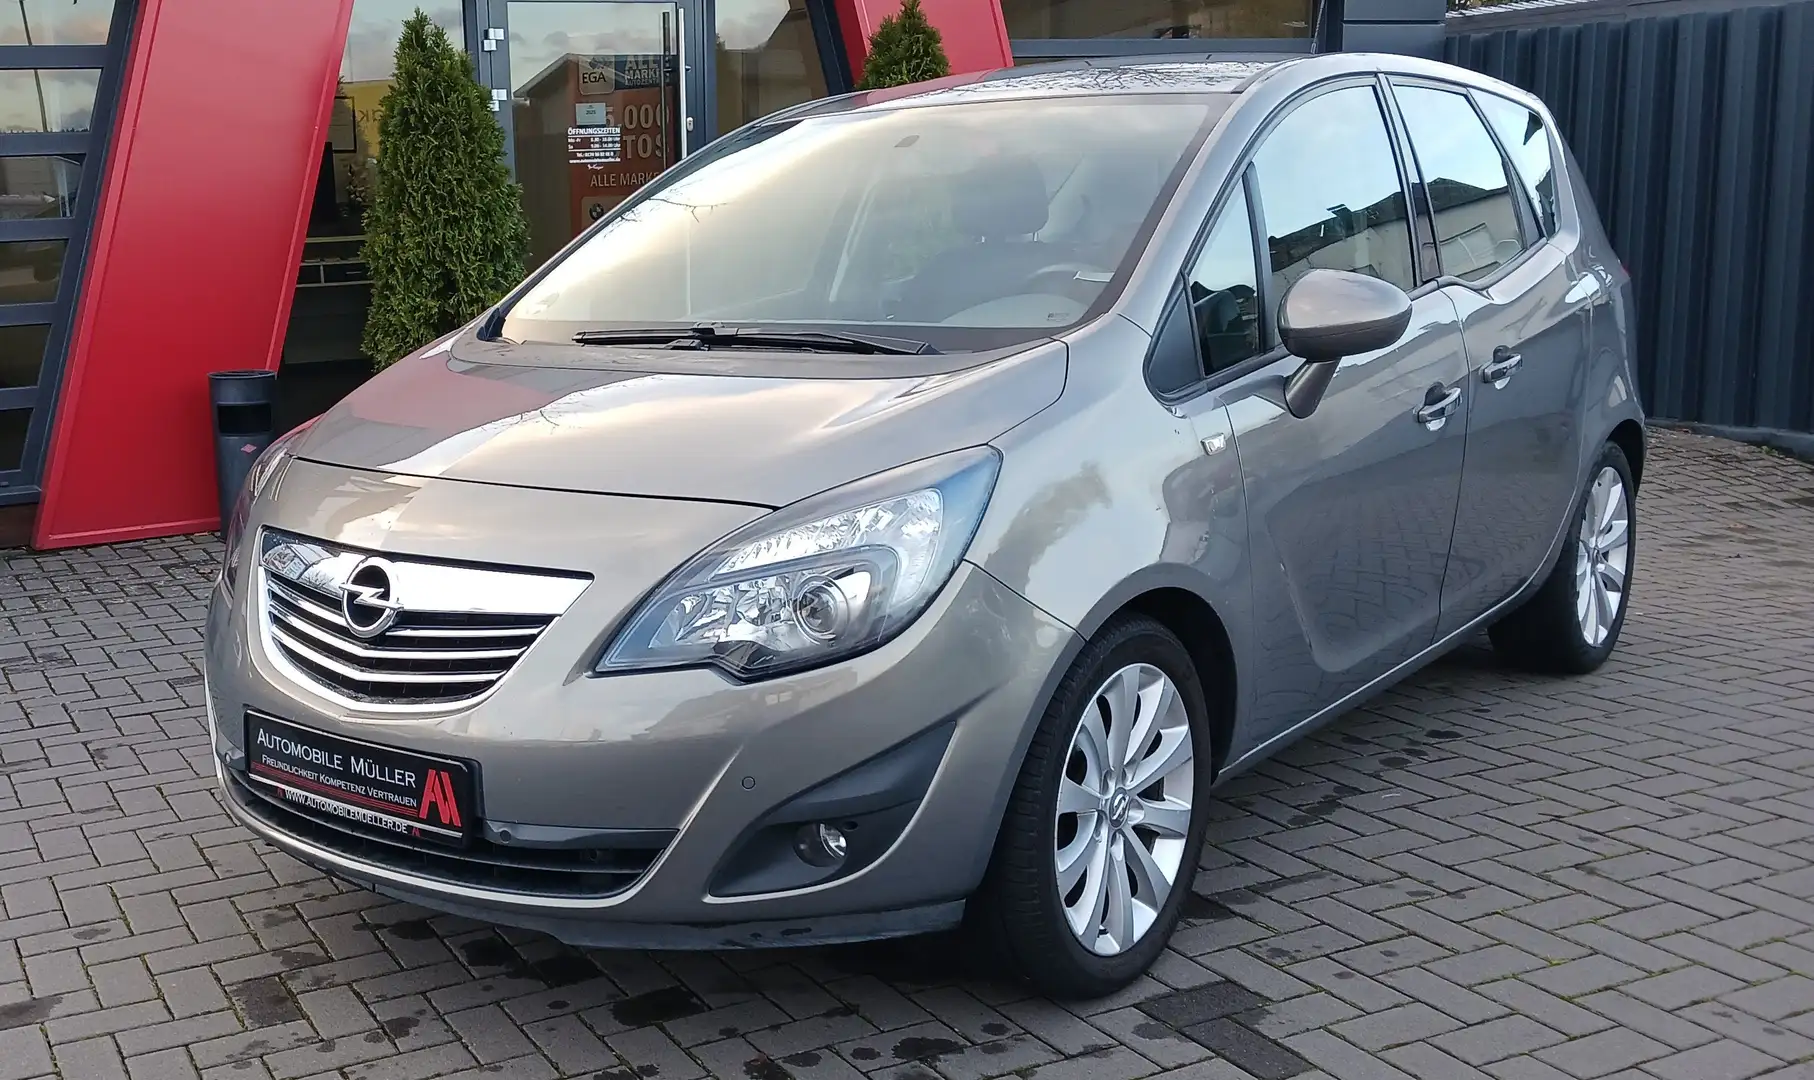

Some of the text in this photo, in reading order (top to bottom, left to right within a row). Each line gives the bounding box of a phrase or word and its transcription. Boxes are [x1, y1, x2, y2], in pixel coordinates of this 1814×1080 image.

[582, 71, 607, 84] EGA
[567, 126, 621, 135] ÖFFNUNGSZEITEN
[590, 173, 617, 187] ALLE
[257, 728, 416, 788] AUTOMOBILE MÜLLER
[262, 754, 417, 808] FREUNDLICHKEIT KOMPETENZ VERTRAUEN
[285, 788, 408, 834] WWW.AUTOMOBILEMUELLER.DE
